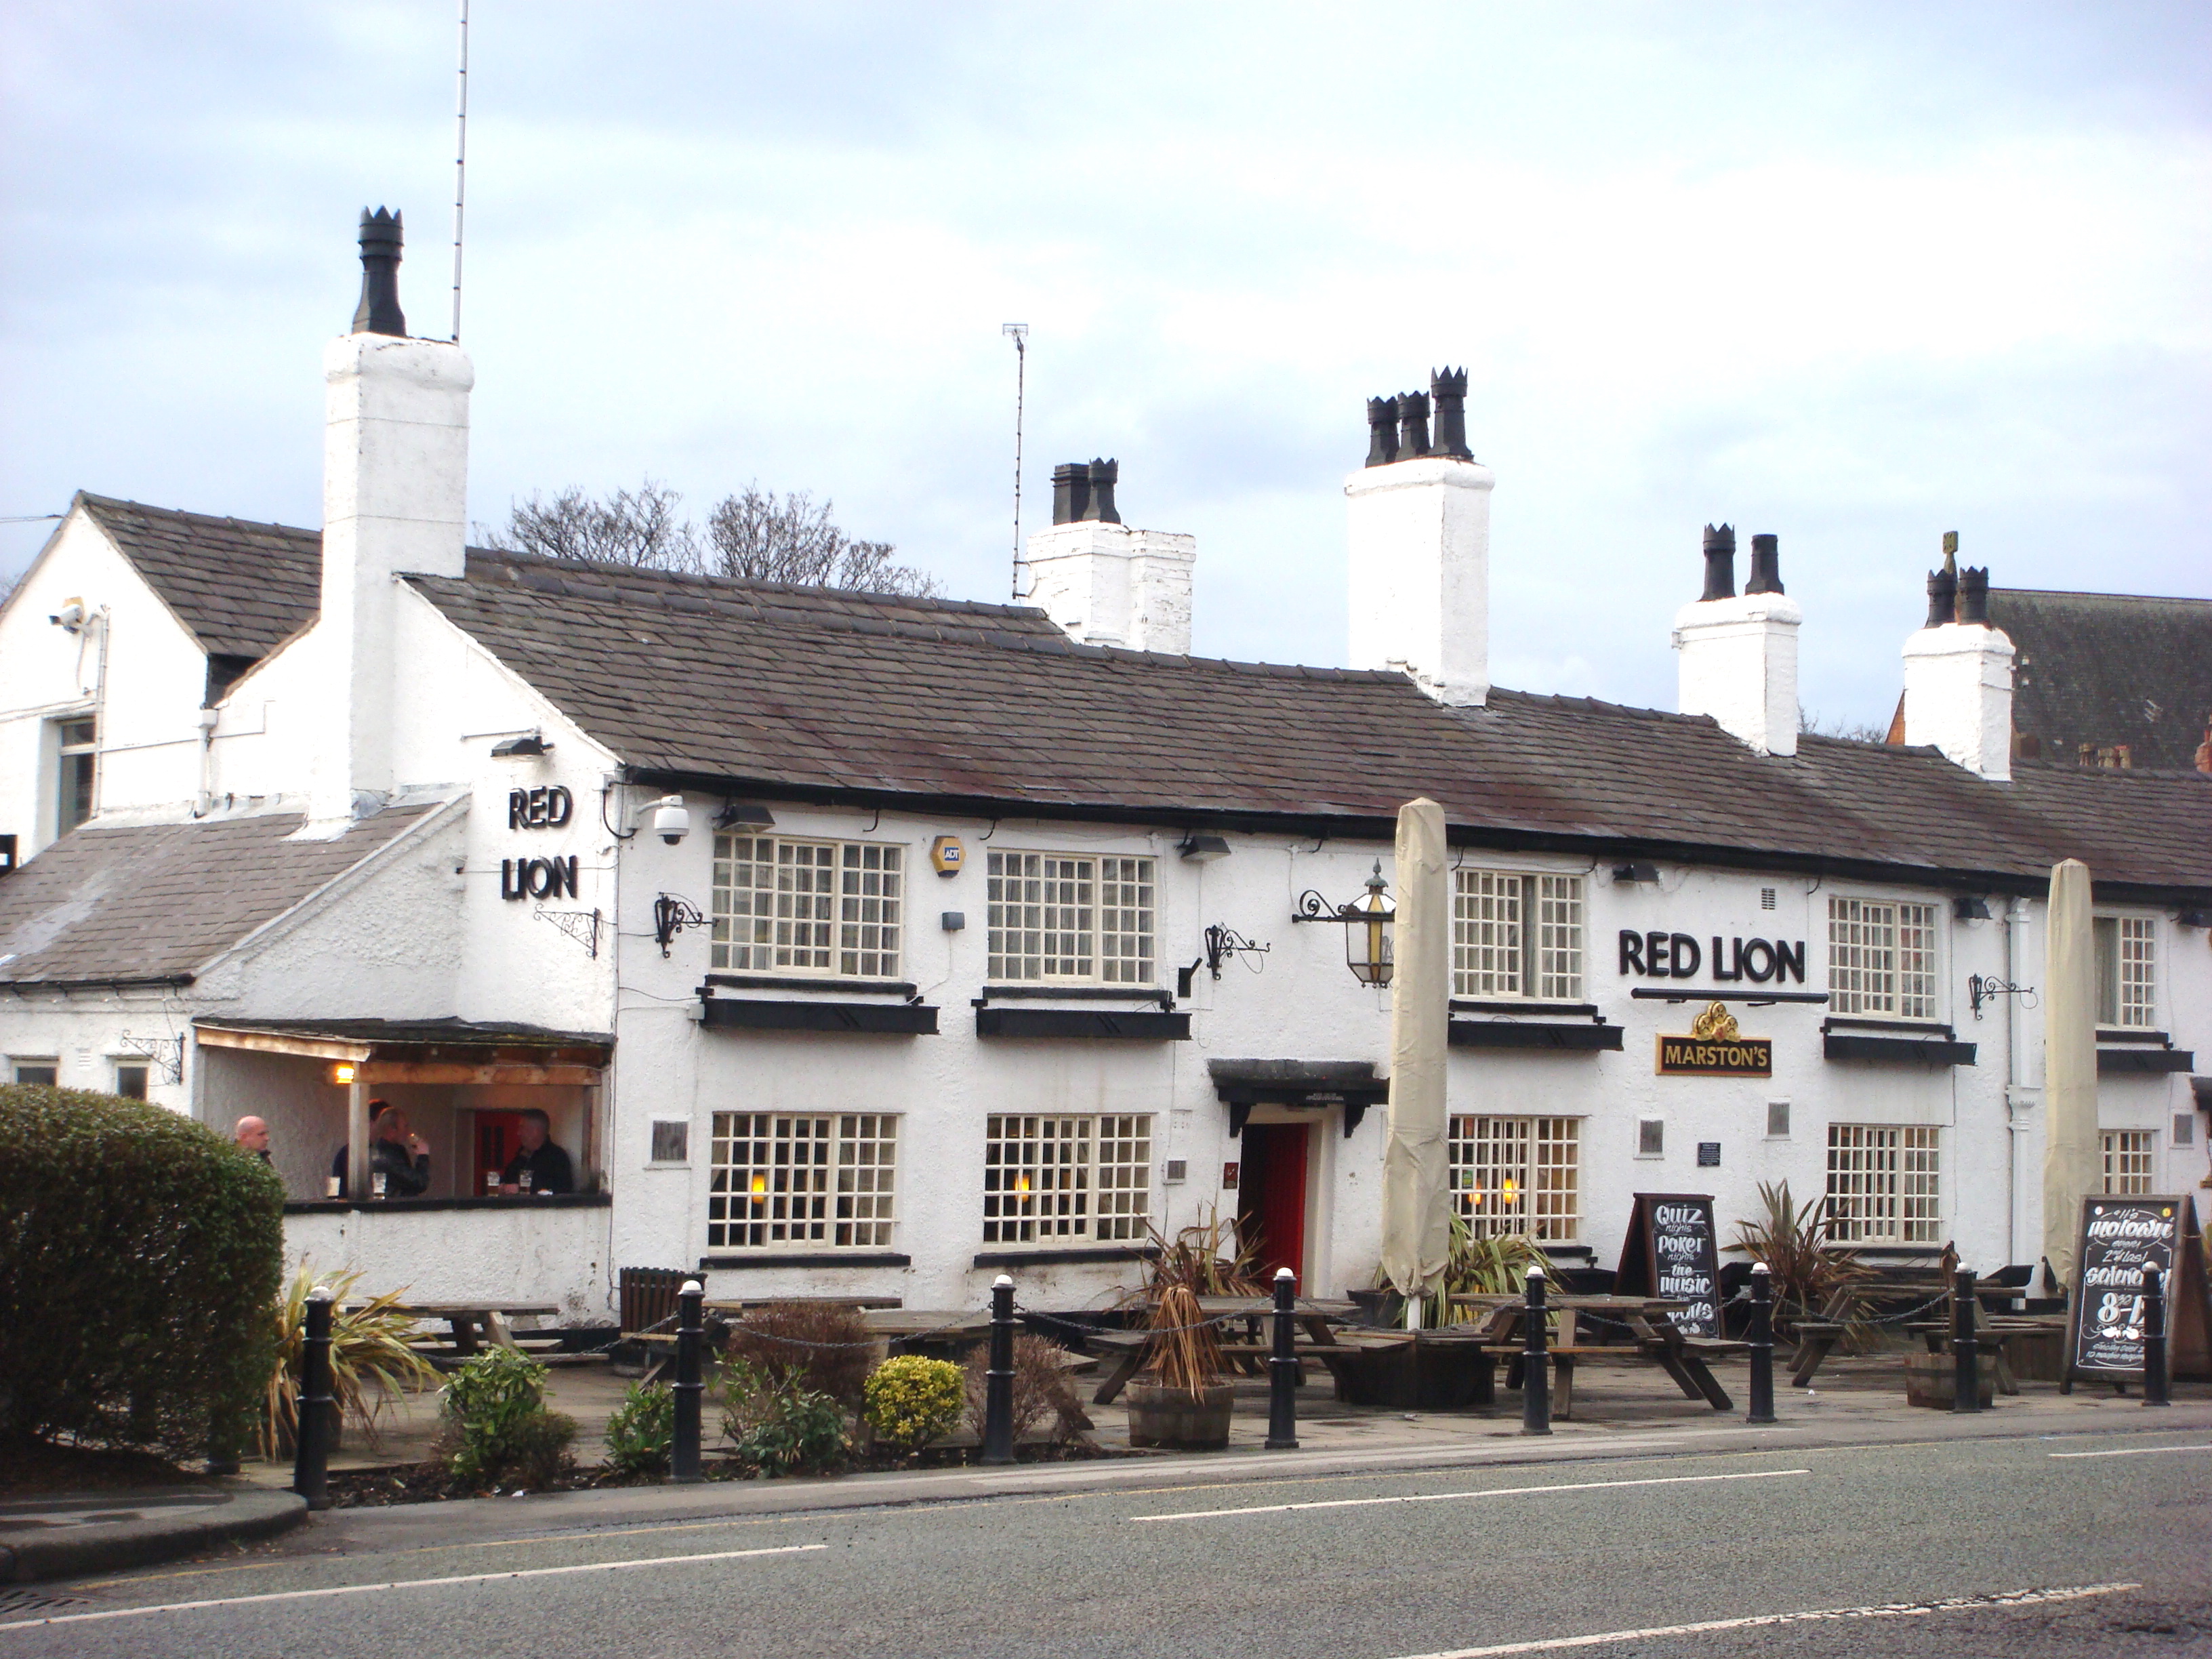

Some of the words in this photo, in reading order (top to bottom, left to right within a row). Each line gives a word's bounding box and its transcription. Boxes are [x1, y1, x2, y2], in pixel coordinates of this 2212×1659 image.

[509, 786, 573, 830] RED
[945, 849, 960, 859] ADT
[502, 855, 577, 900] LION
[1619, 929, 1701, 979] RED
[1713, 936, 1805, 983] LION
[1665, 1045, 1767, 1067] MARSTON'S
[1656, 1204, 1706, 1227] Quiz
[1666, 1223, 1692, 1234] nights
